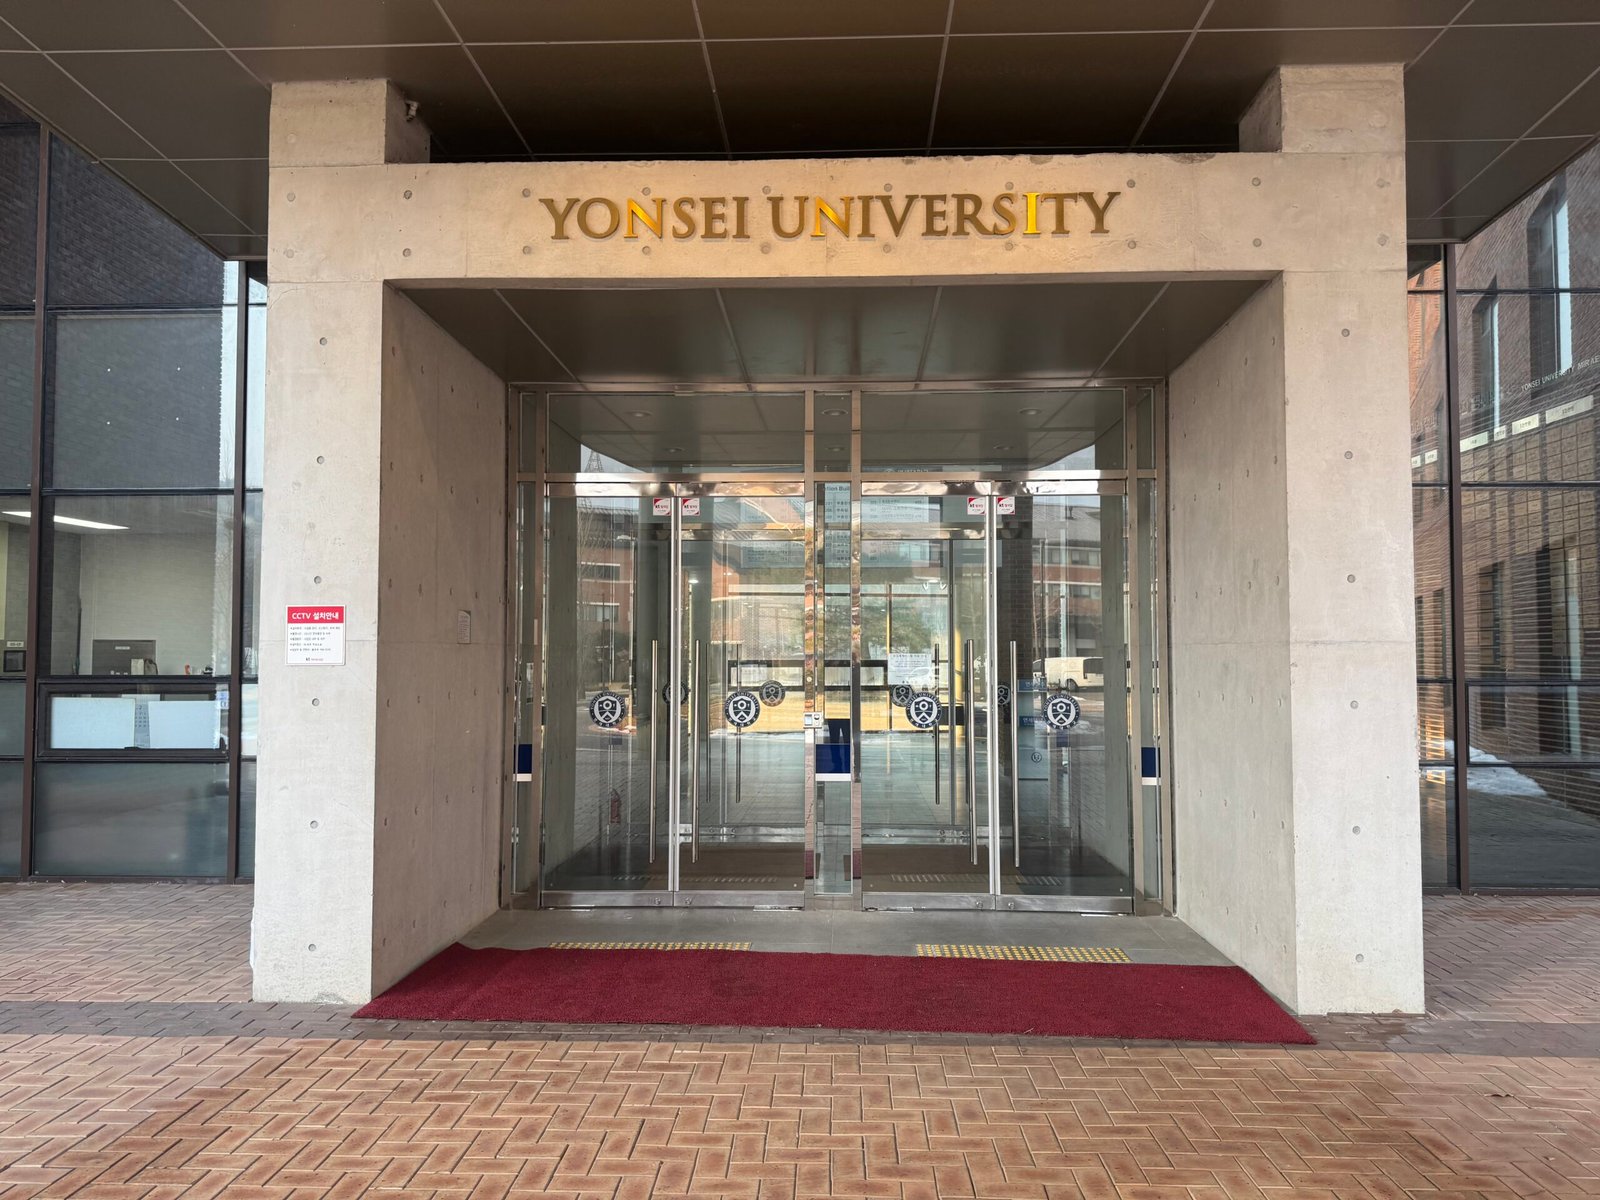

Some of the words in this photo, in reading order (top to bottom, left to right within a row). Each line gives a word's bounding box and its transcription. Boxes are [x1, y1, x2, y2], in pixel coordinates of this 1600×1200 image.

[538, 196, 750, 239] YONSEI
[767, 191, 1121, 238] UNIVERSITY
[291, 612, 311, 620] CCTV
[313, 611, 339, 621] 설치안내
